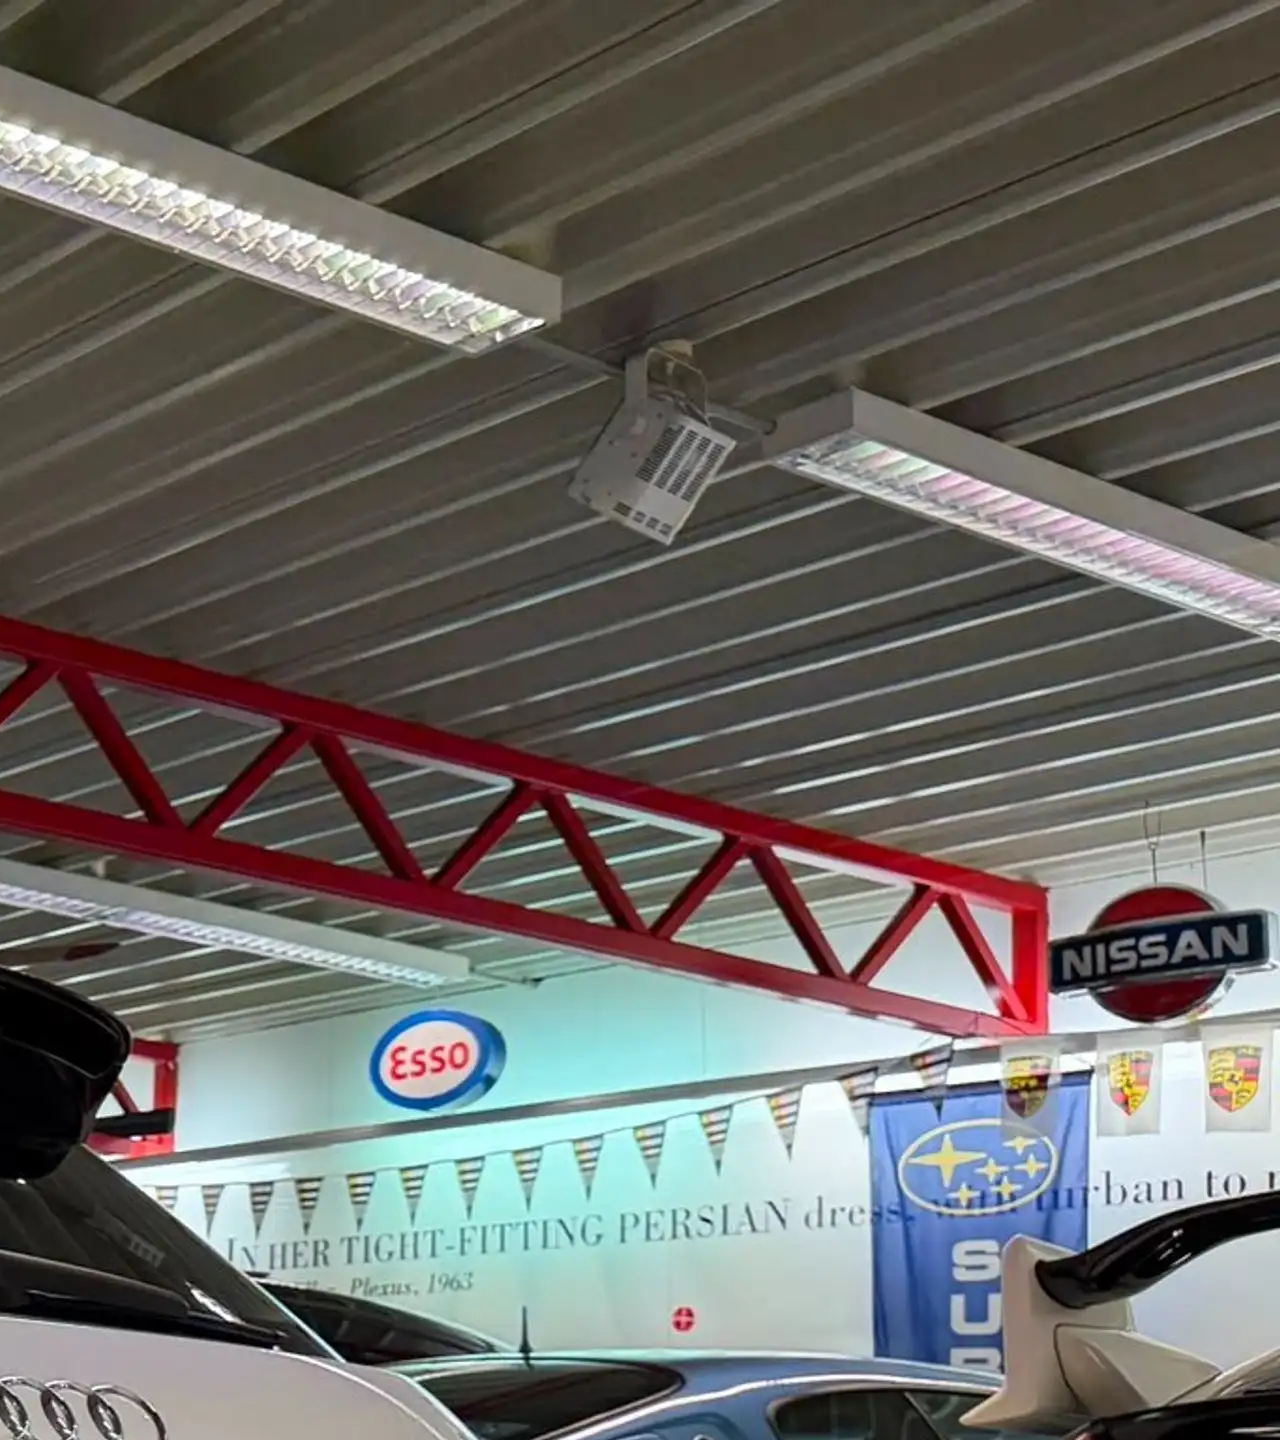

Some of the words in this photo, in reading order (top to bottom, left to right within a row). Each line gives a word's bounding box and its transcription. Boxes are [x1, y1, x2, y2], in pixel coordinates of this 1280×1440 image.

[1061, 923, 1250, 981] NISSAN
[268, 1237, 331, 1271] HER
[340, 1213, 604, 1267] TIGHT-FITTING
[618, 1197, 792, 1246] PERSIAN
[1207, 1169, 1247, 1199] to
[427, 1271, 475, 1295] 1963
